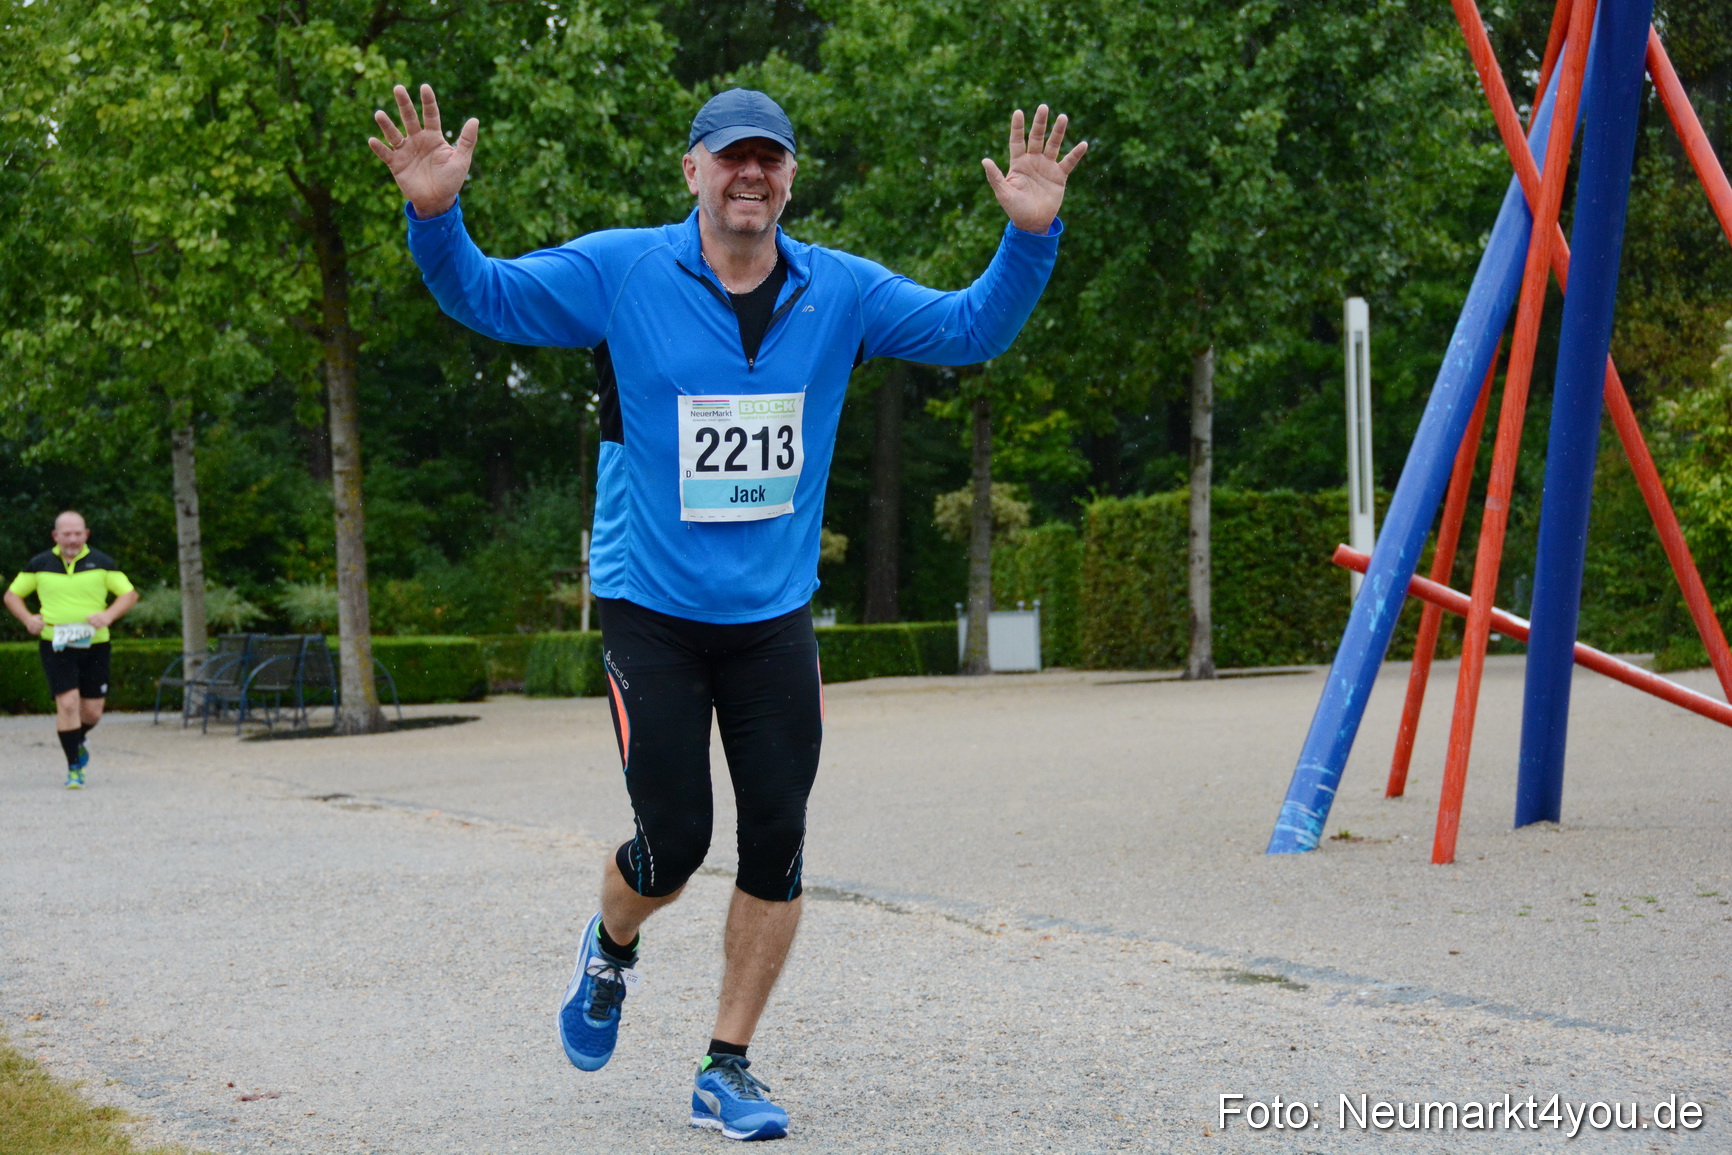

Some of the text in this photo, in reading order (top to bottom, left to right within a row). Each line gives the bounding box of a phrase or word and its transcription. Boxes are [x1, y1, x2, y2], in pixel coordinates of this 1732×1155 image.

[738, 398, 796, 414] BOCK
[695, 425, 795, 472] 2213
[685, 470, 692, 478] D
[730, 485, 766, 503] Jack
